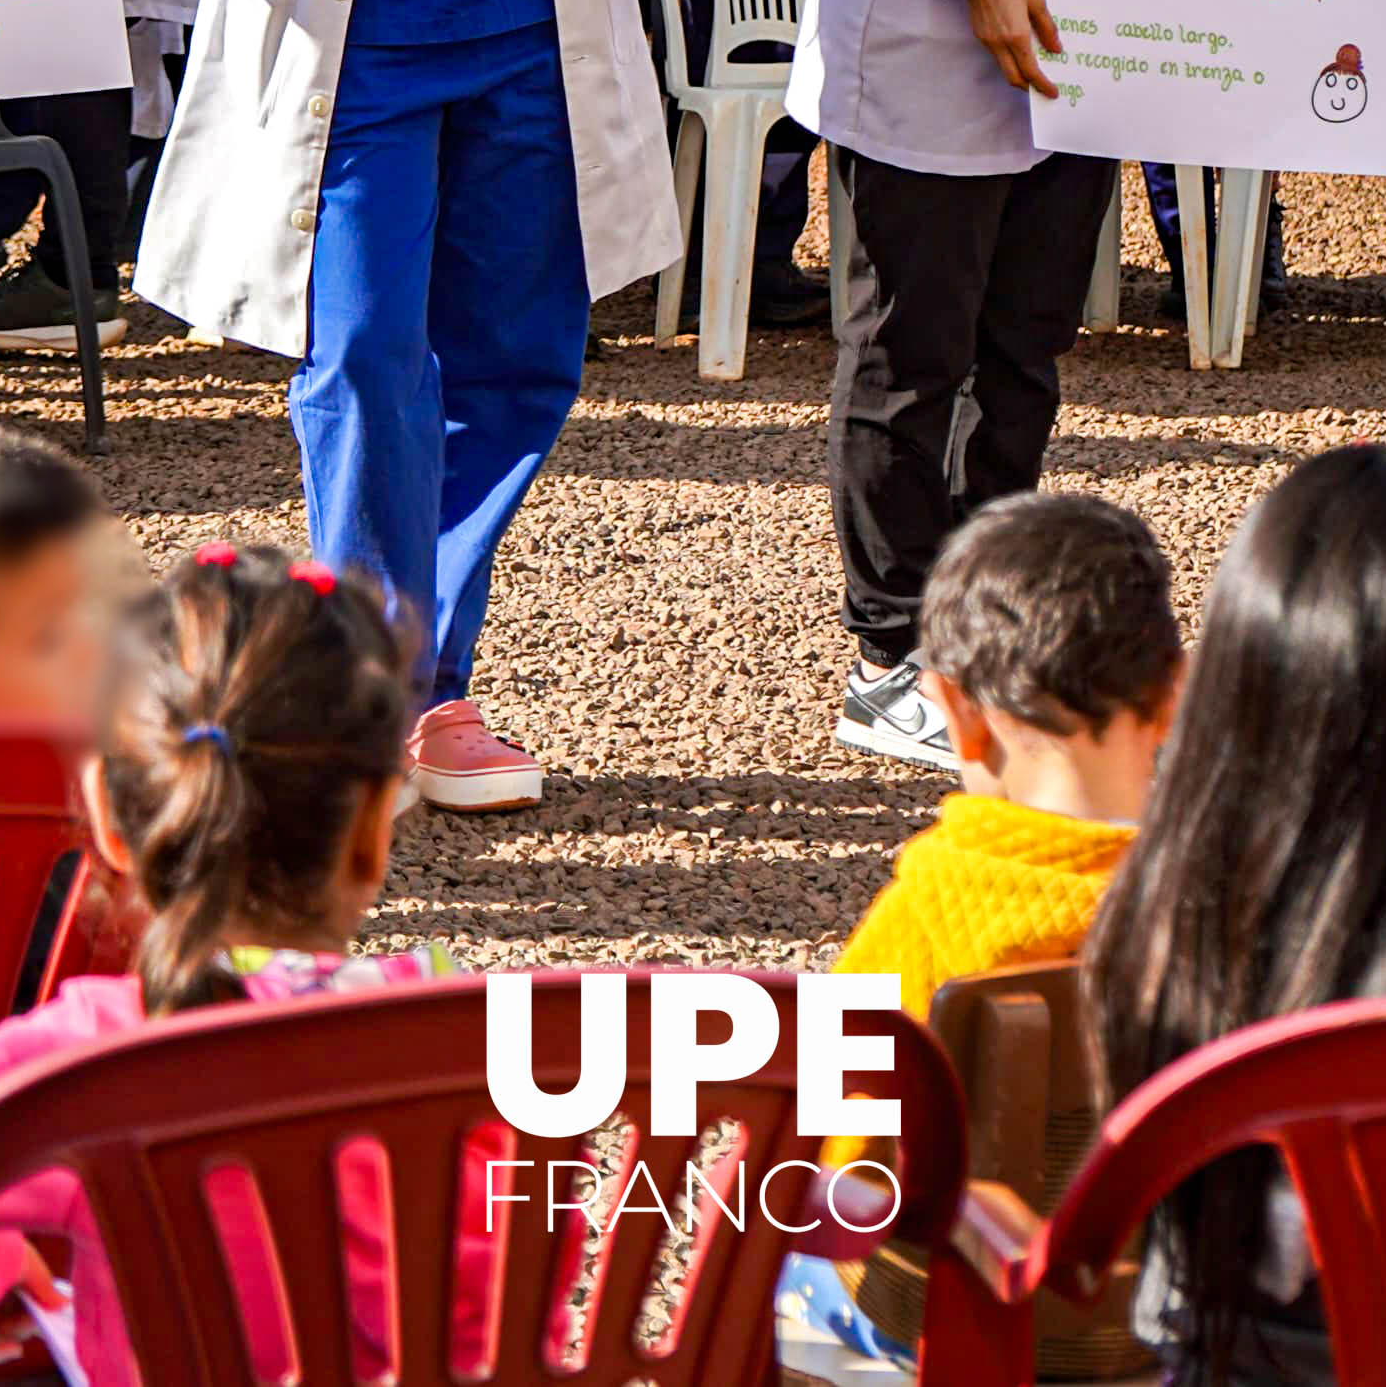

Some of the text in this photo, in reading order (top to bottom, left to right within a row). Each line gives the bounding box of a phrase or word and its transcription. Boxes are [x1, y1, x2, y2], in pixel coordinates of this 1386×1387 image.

[1115, 22, 1174, 42] cabello
[1075, 52, 1151, 81] recogido
[1159, 60, 1179, 76] en
